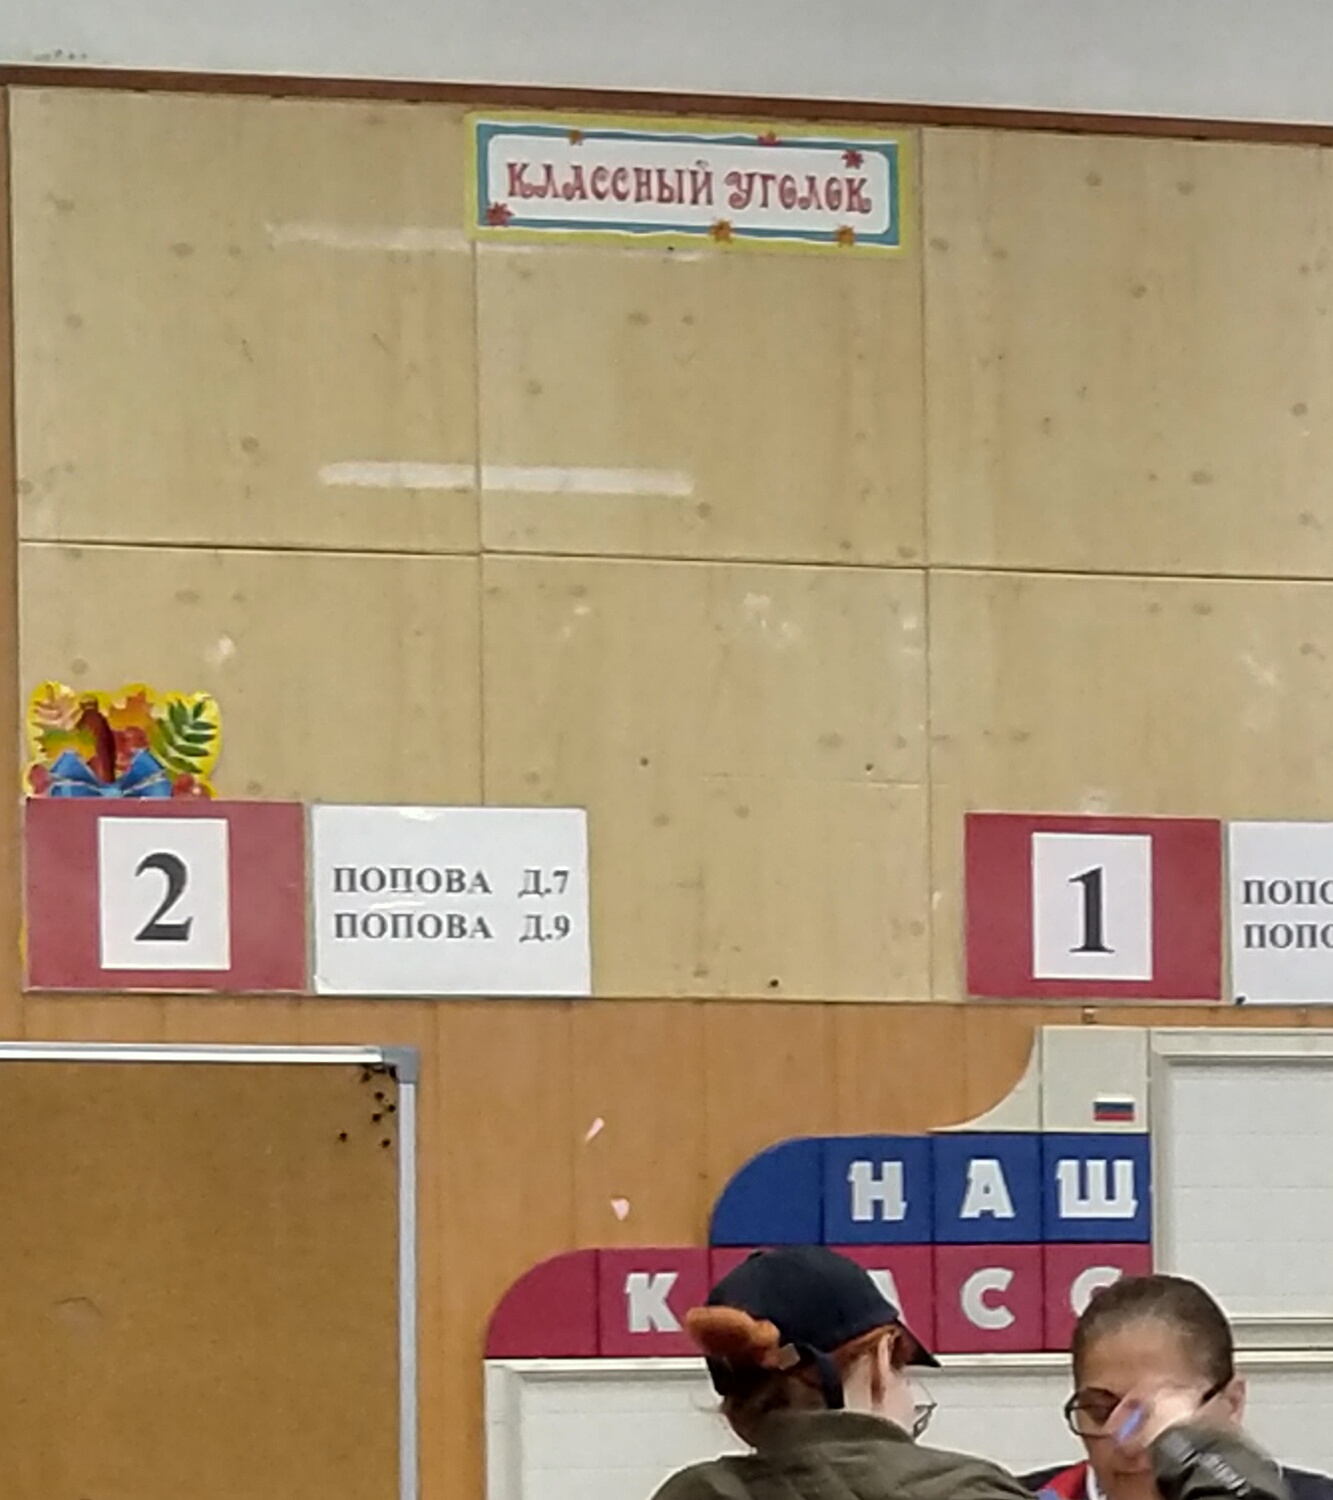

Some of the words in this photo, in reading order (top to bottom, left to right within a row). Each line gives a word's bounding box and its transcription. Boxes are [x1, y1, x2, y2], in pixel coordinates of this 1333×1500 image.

[506, 159, 713, 207] КЛАССНЫЙ
[725, 171, 872, 214] УГОЛОК
[133, 851, 194, 943] 2
[333, 867, 493, 895] ПОПОВА
[517, 869, 570, 897] Д.7
[1068, 865, 1116, 955] 1
[333, 912, 494, 941] ПОПОВА
[518, 913, 571, 942] Д.9
[847, 1159, 1138, 1221] НАШ
[623, 1265, 1124, 1333] КСС
